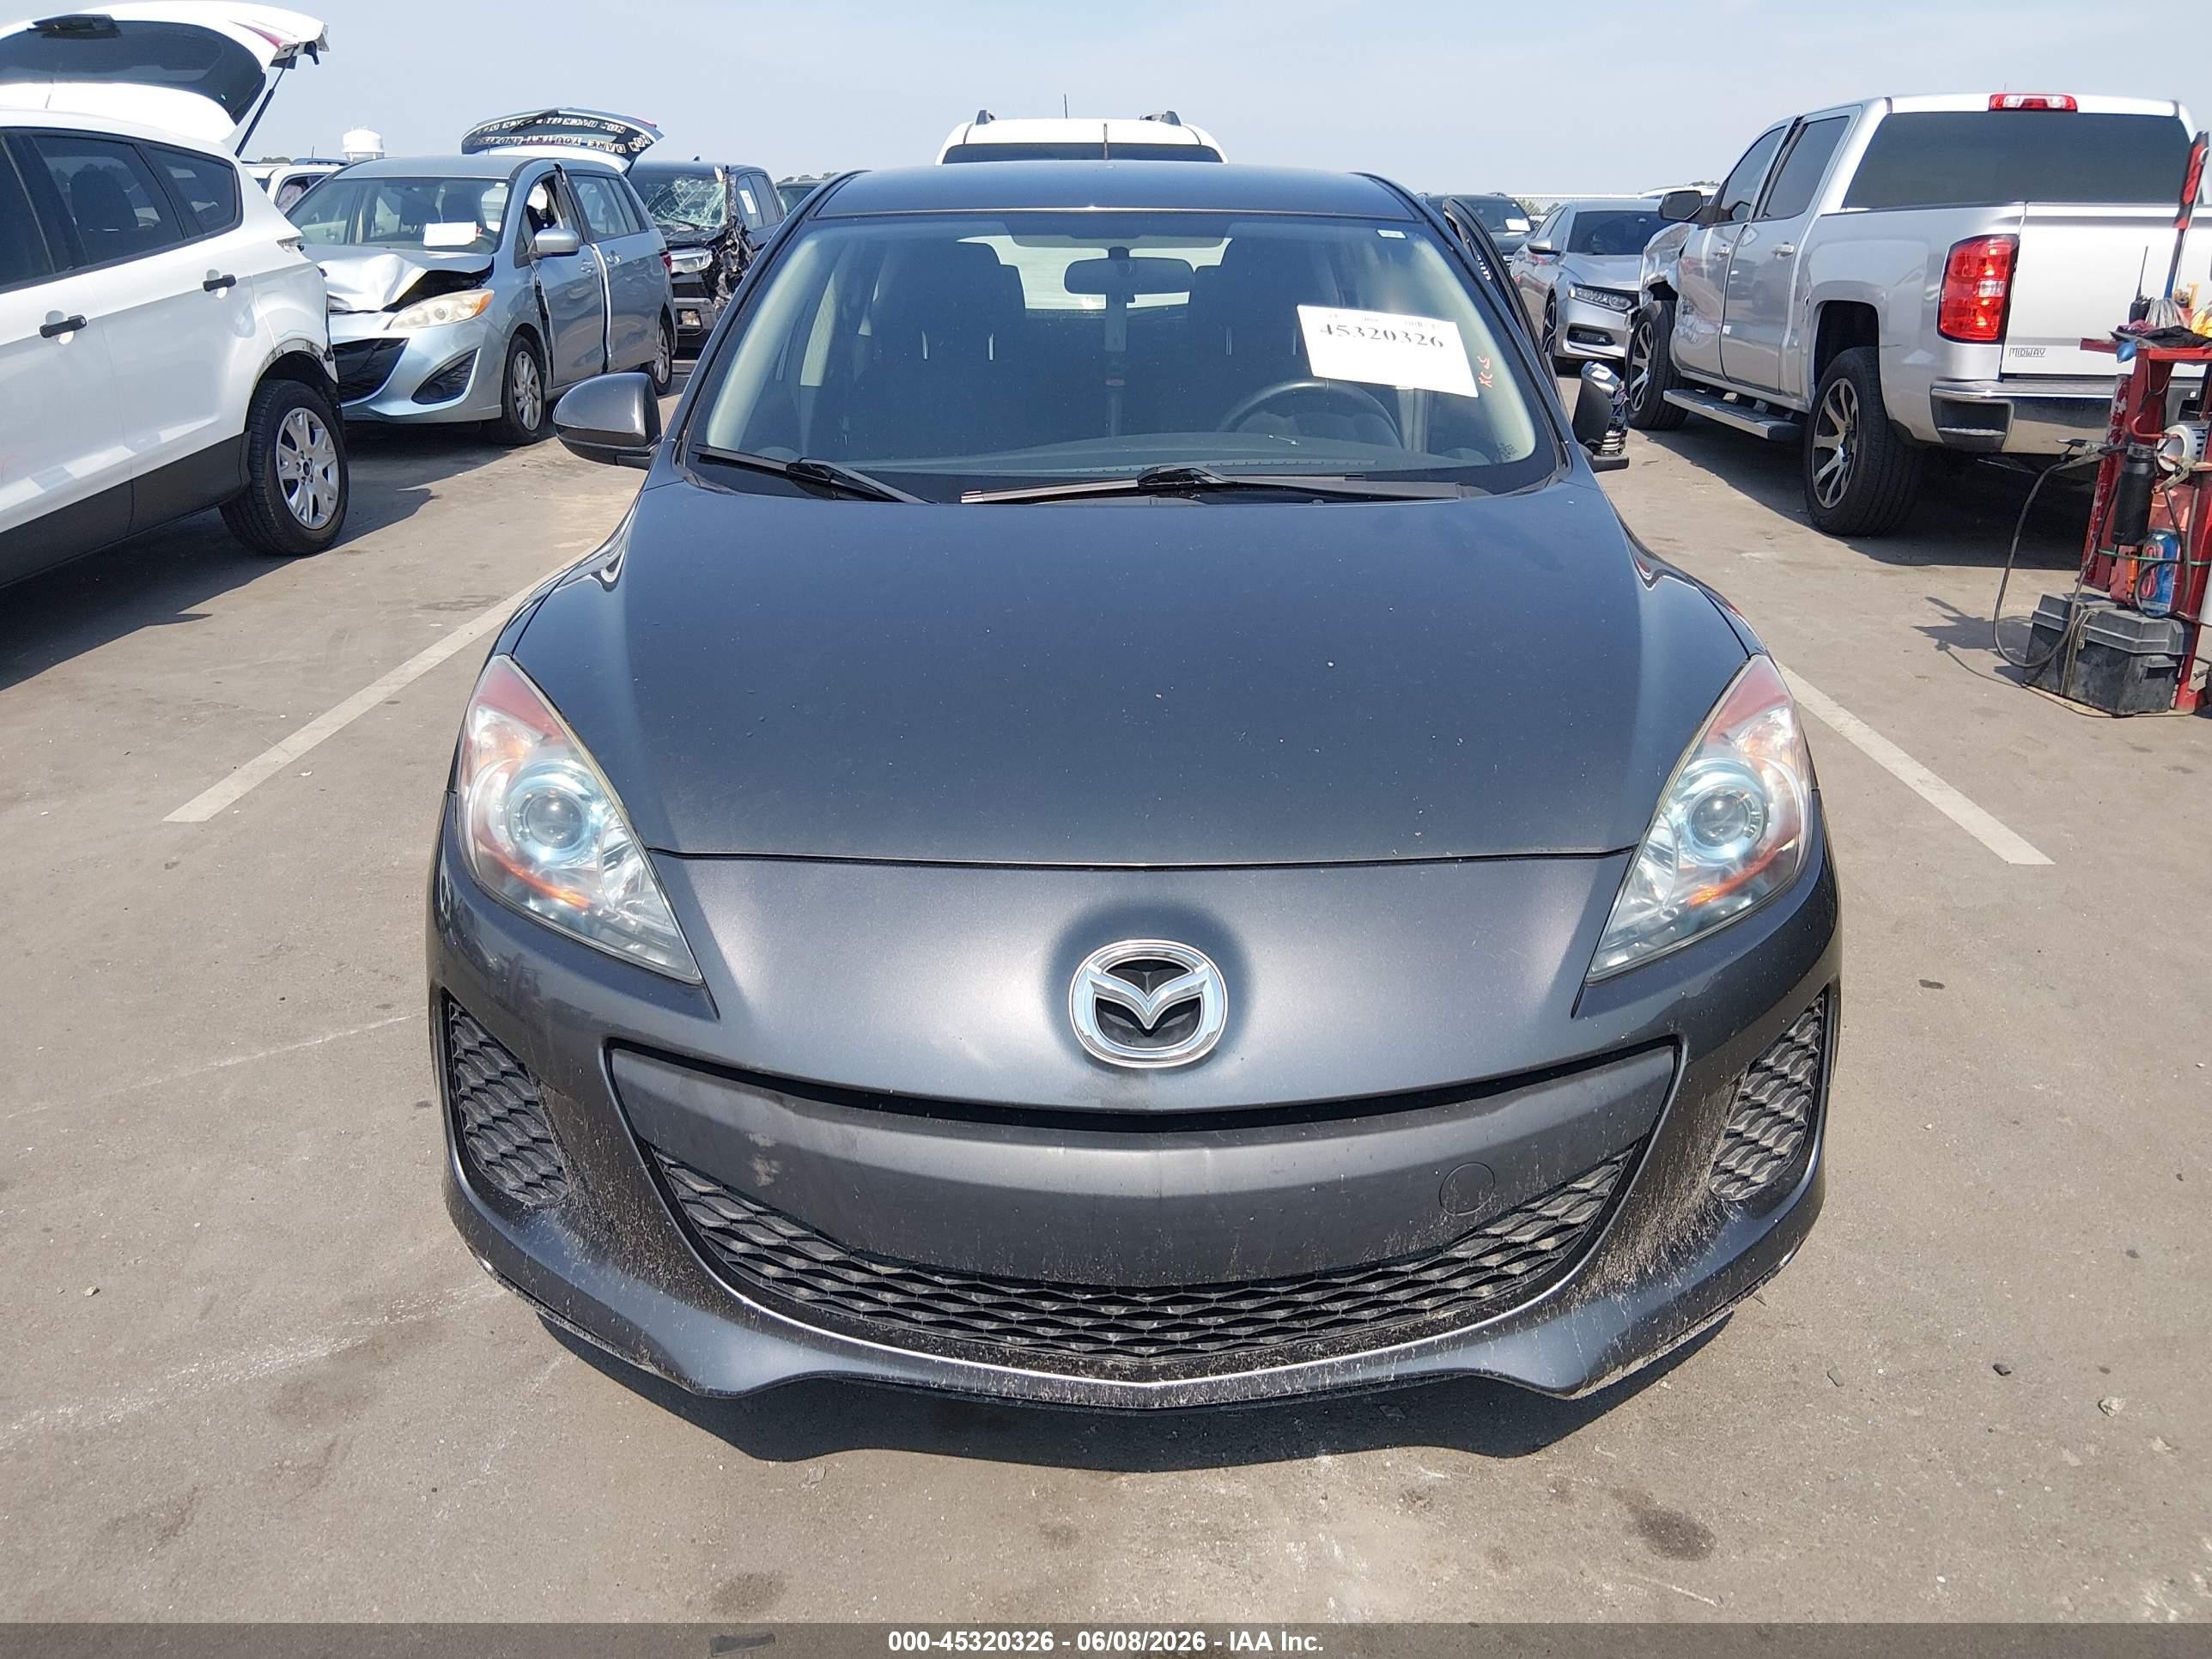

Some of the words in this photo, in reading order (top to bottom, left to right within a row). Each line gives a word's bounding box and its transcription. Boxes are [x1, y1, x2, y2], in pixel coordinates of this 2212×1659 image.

[589, 140, 626, 153] DARE
[1320, 324, 1443, 348] 45320326
[2009, 348, 2046, 357] MIDWAY
